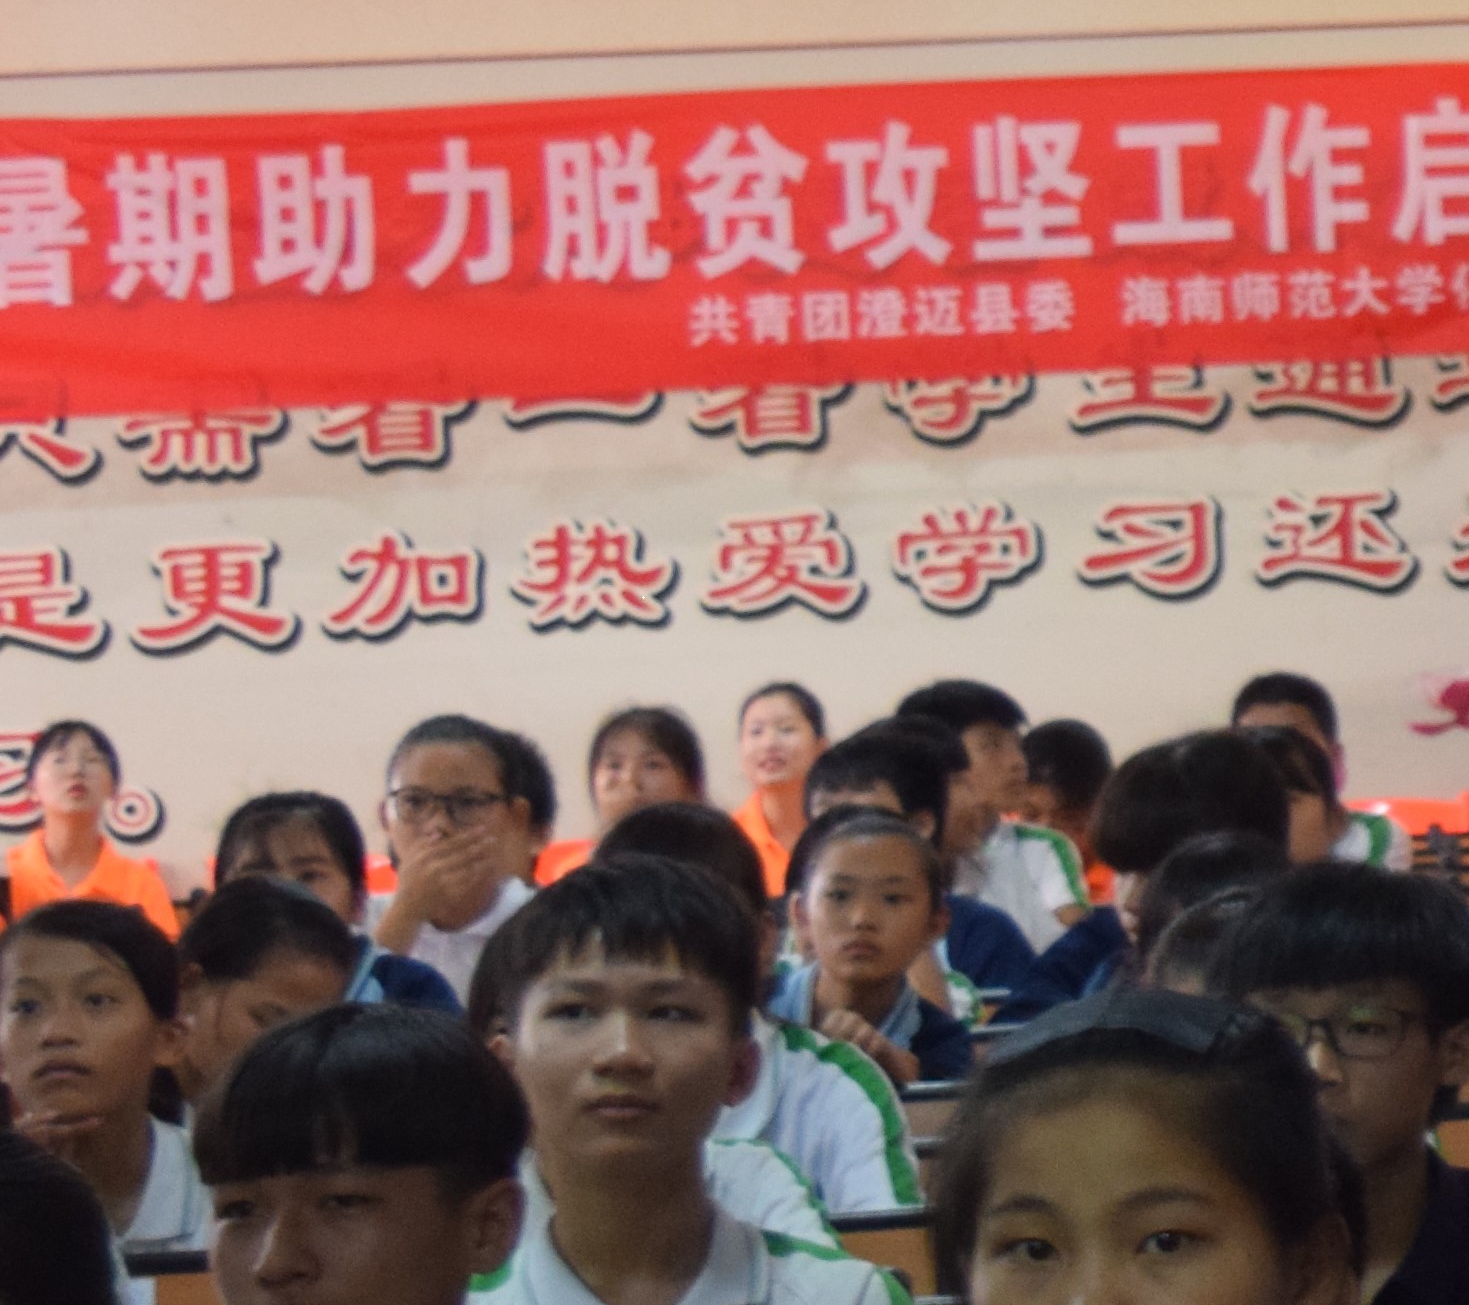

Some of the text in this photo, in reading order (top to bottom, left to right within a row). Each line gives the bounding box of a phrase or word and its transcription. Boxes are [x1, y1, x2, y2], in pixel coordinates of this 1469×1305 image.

[688, 276, 1077, 347] 共青团澄迈县委
